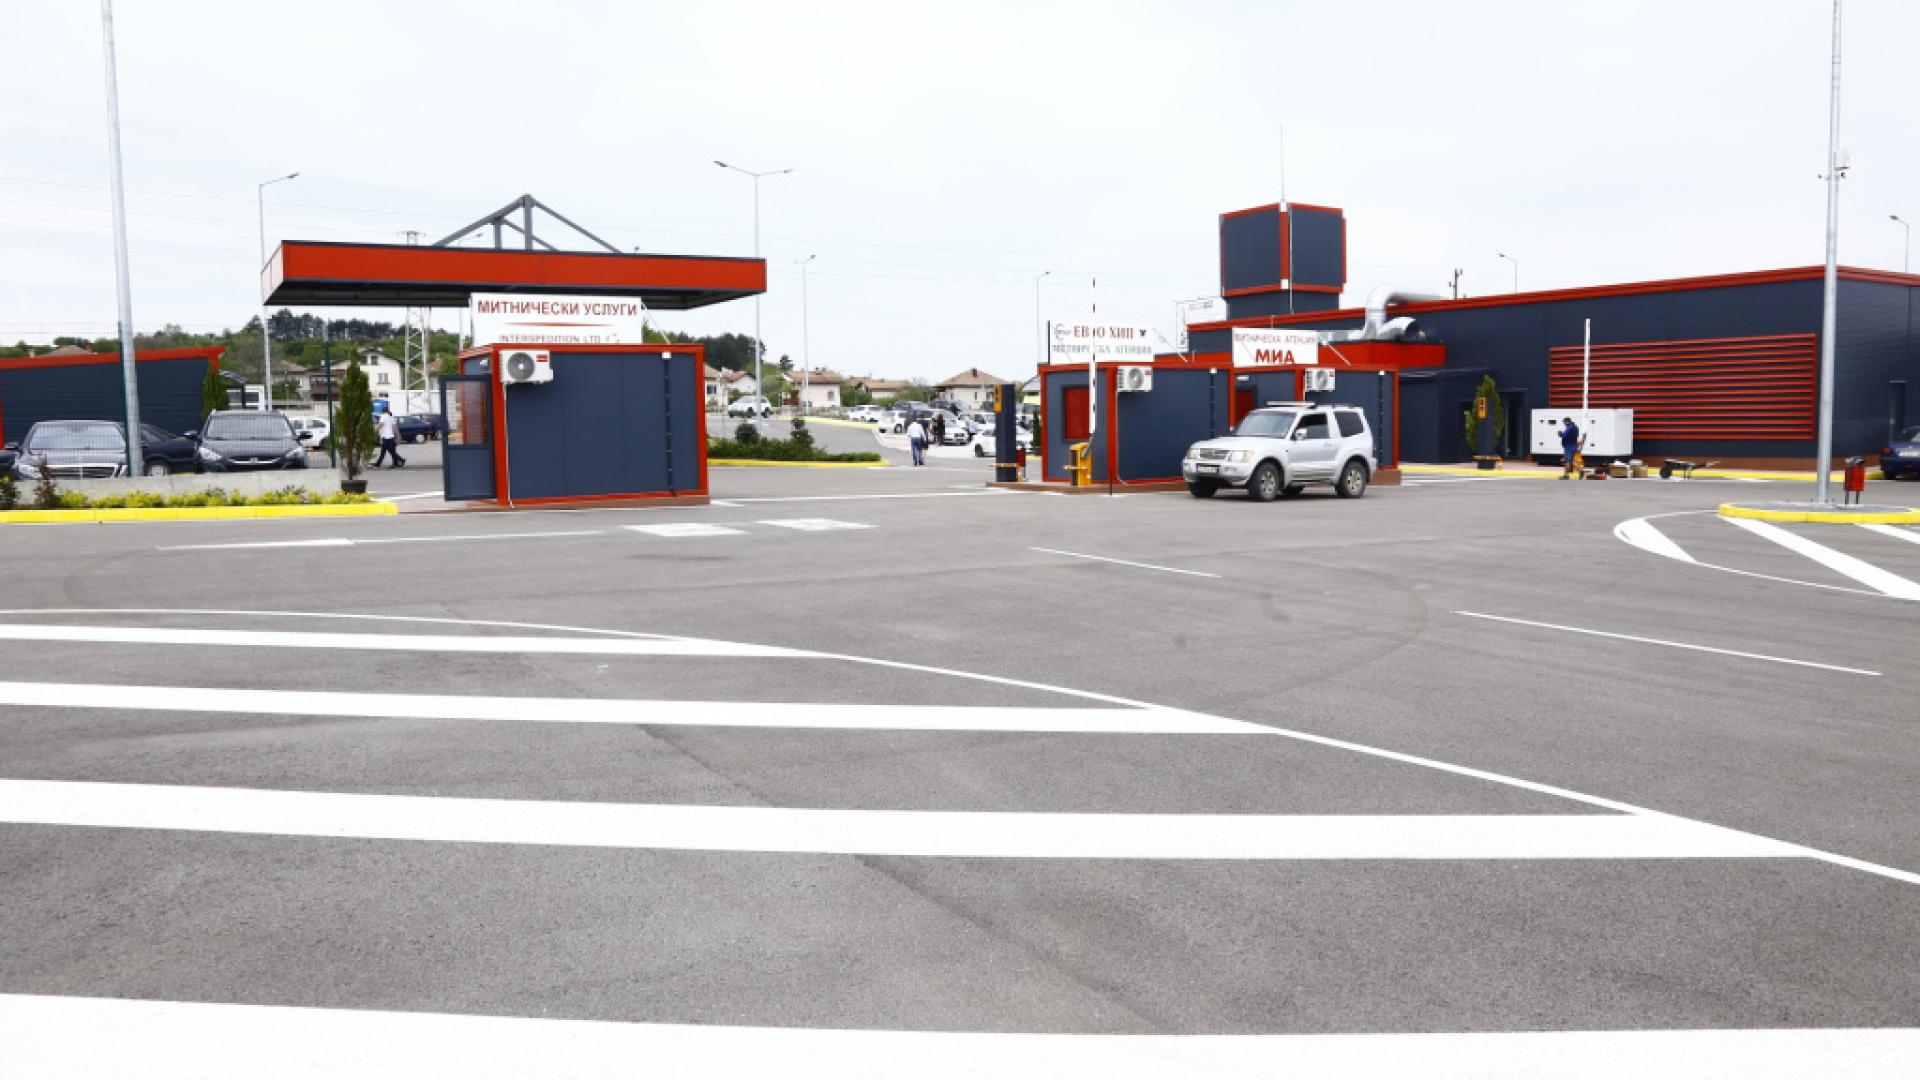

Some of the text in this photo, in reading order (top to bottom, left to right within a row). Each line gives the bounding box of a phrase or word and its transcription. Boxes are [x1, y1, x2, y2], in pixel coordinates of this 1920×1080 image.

[477, 301, 637, 316] МИТНИЧЕСКИ УСЛУГИ
[1073, 325, 1105, 338] ЕВО
[499, 334, 580, 343] INTERSPEDITION
